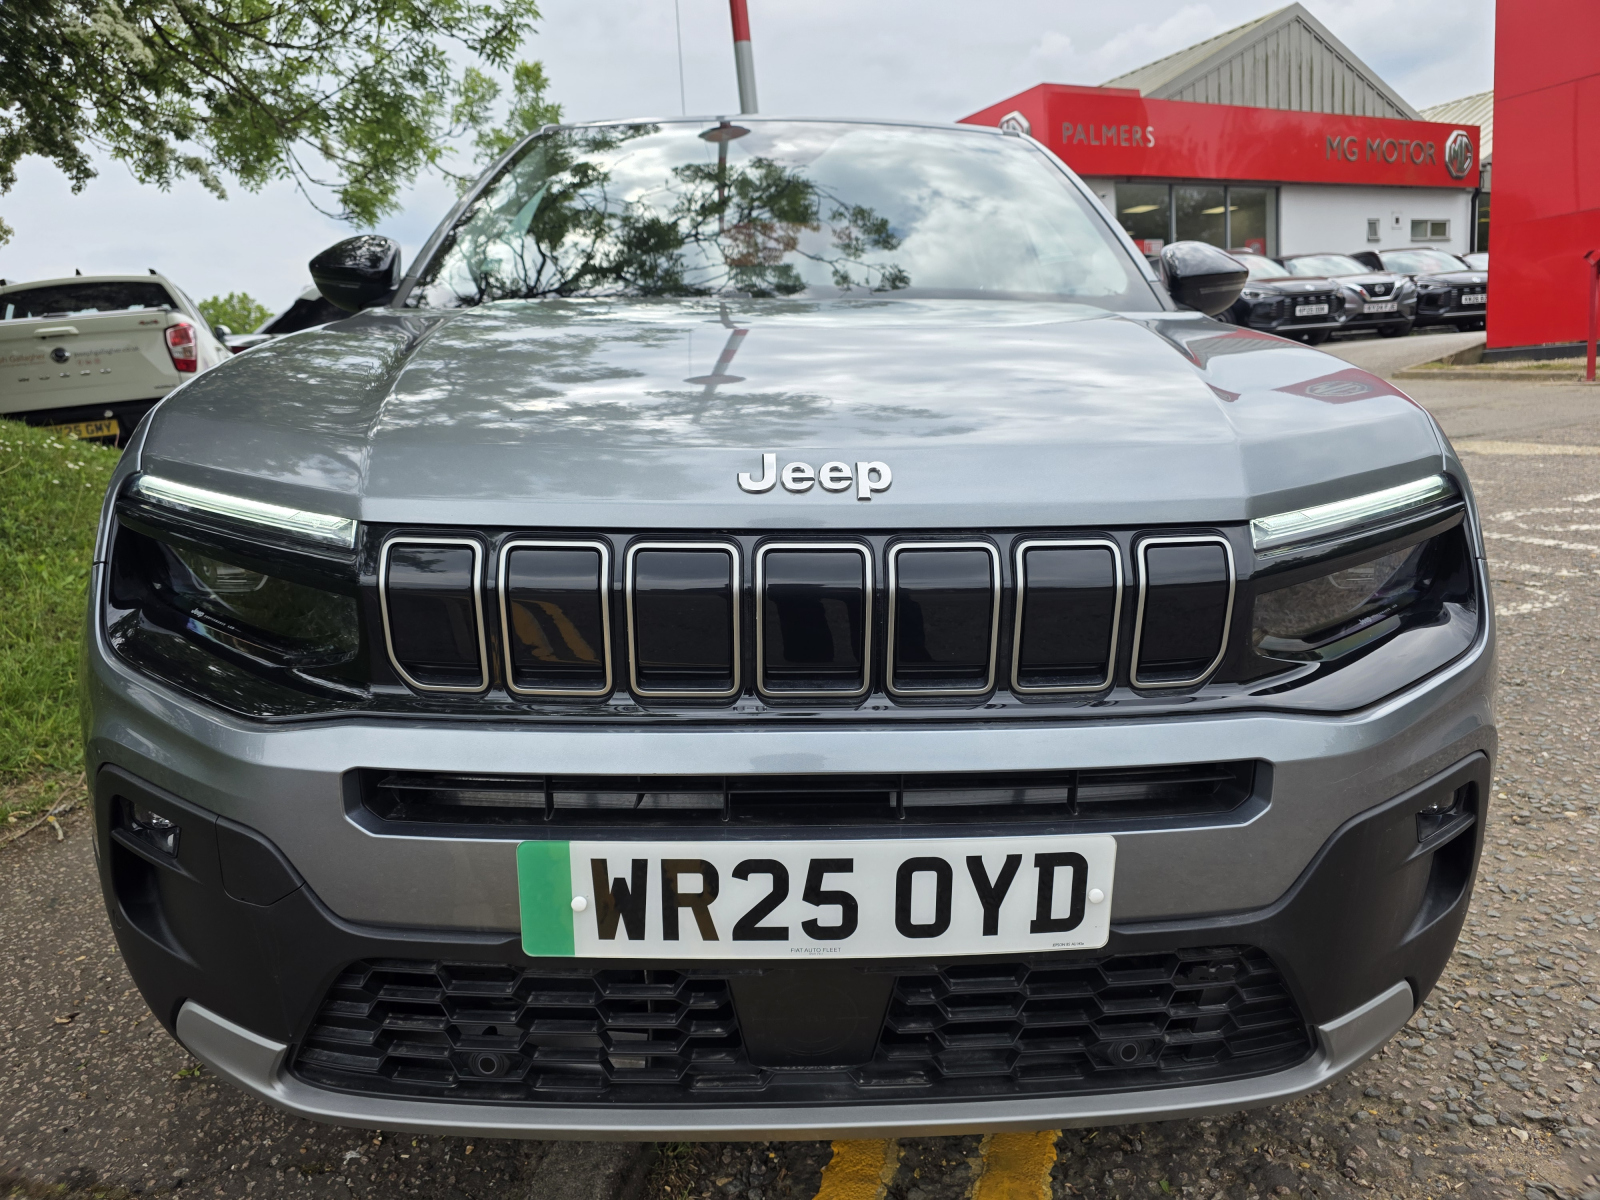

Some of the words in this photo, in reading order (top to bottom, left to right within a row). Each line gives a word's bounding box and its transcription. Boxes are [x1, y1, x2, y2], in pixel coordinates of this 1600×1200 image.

[1062, 122, 1155, 148] PALMERS
[1326, 136, 1358, 161] MG
[1366, 138, 1436, 165] MOTOR
[1448, 133, 1473, 178] MG
[737, 453, 893, 501] Jeep
[590, 858, 859, 942] WR25
[895, 851, 1089, 939] OYD
